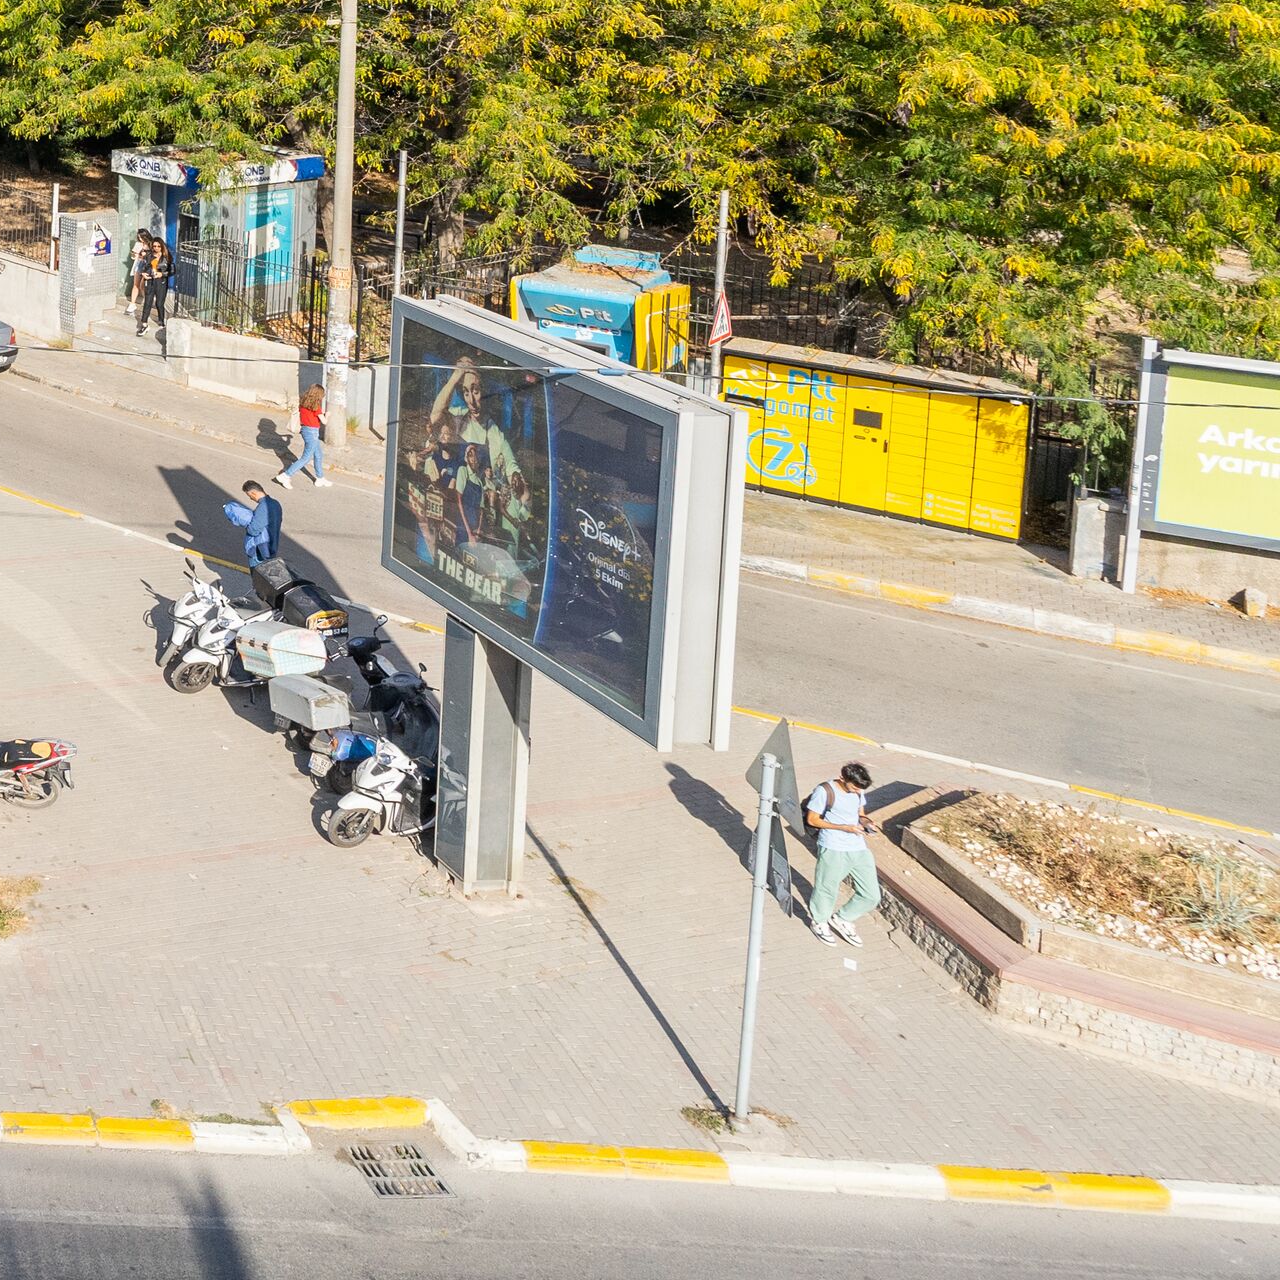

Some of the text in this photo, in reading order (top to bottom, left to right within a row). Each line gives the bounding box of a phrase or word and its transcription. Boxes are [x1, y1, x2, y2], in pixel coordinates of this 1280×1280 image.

[139, 159, 161, 172] QNB
[244, 165, 265, 177] QNB
[579, 307, 613, 323] Ptt
[787, 368, 837, 402] Ptt
[726, 386, 835, 425] gomat
[764, 437, 795, 471] 7
[576, 507, 642, 563] Disney+
[437, 548, 502, 606] THE BEAR
[601, 571, 624, 590] Ekim
